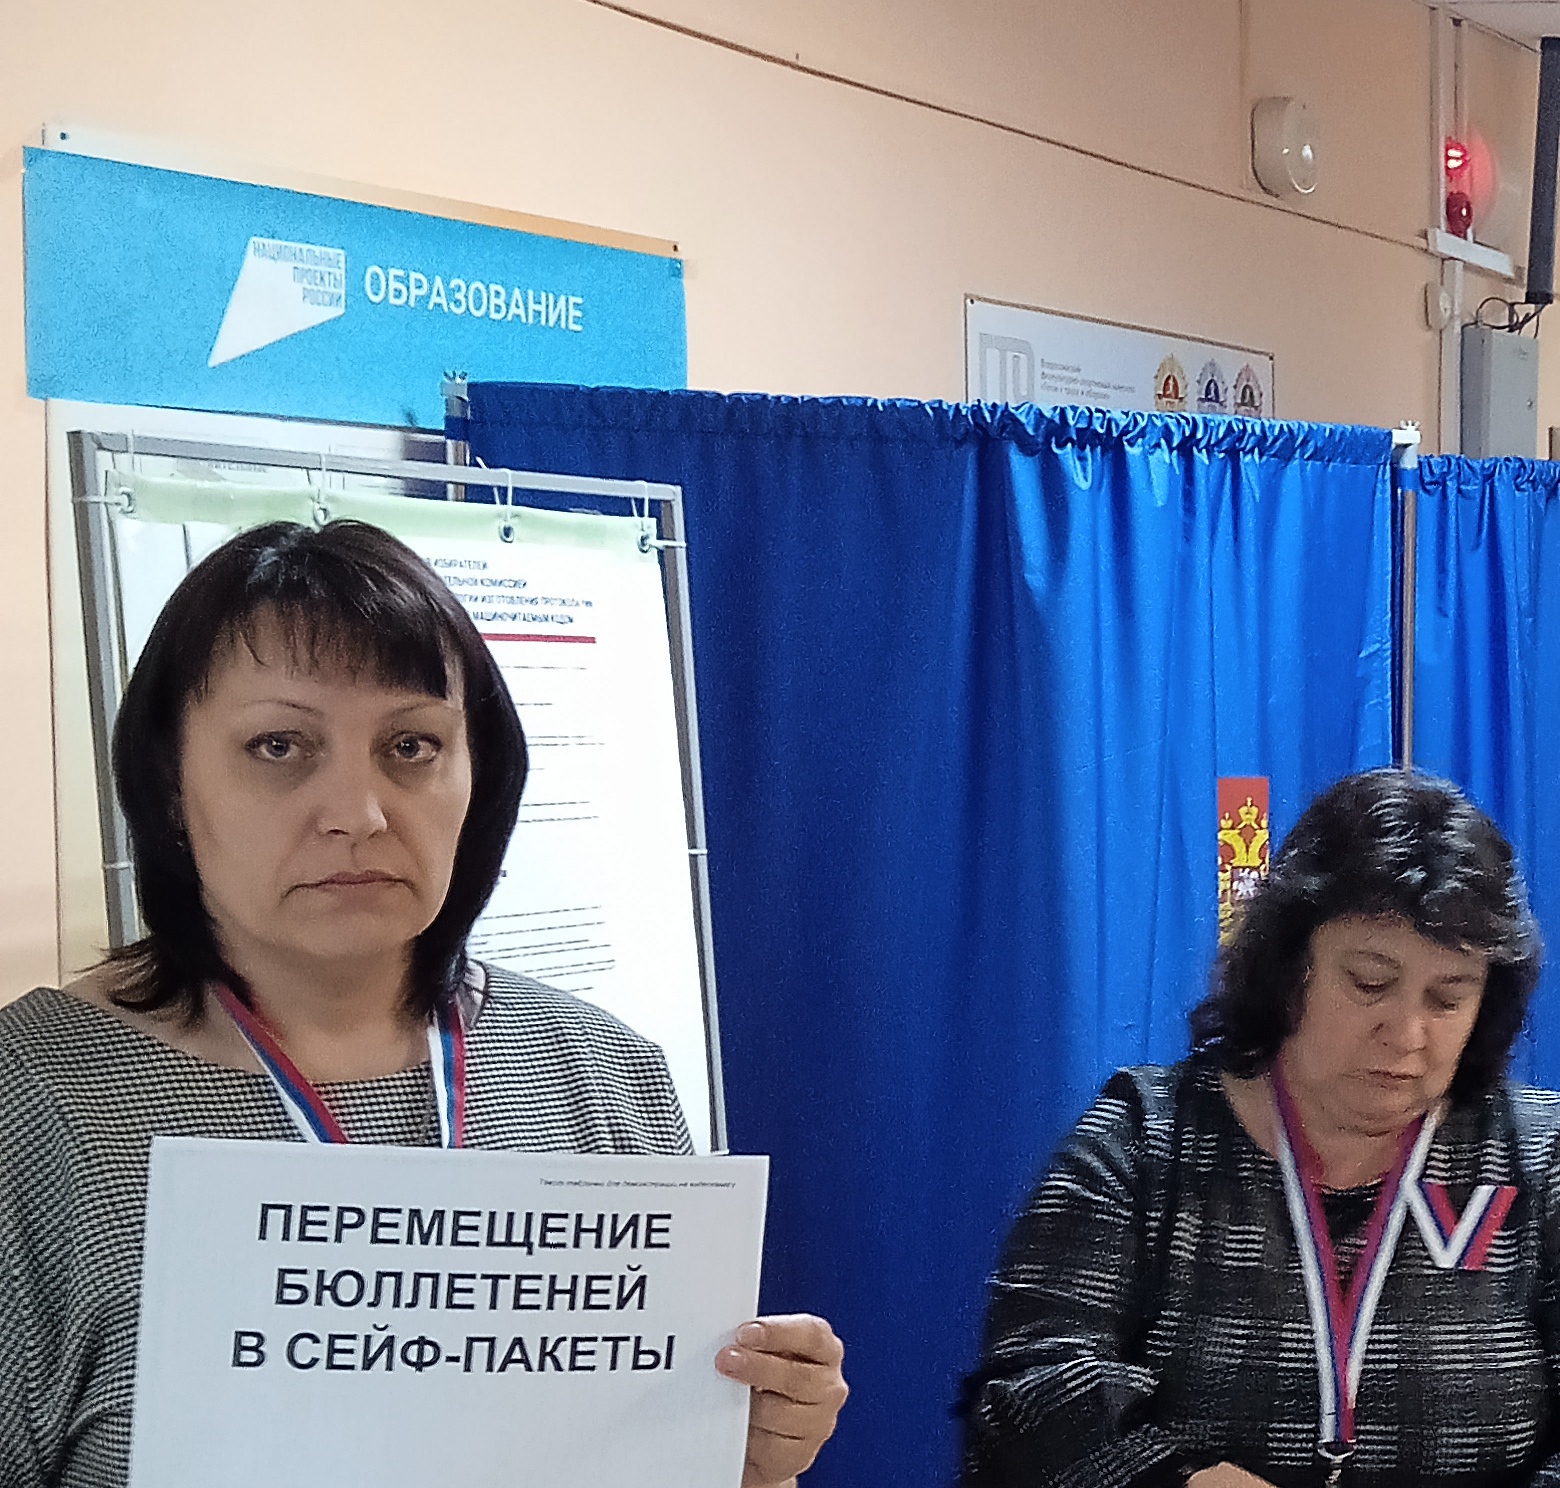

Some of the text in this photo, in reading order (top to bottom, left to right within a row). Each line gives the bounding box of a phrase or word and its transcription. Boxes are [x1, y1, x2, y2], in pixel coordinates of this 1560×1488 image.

[253, 240, 342, 270] НАЦИОНАЛЬНЫЕ
[293, 266, 343, 289] ПРОЕКТЫ
[302, 286, 343, 309] РОССИИ
[364, 264, 584, 332] ОБРАЗОВАНИЕ
[257, 1203, 673, 1255] ПЕРЕМЕЩЕНИЕ
[274, 1264, 647, 1311] БЮЛЛЕТЕНЕЙ
[231, 1323, 676, 1373] В СЕЙФ-ПАКЕТЫ
